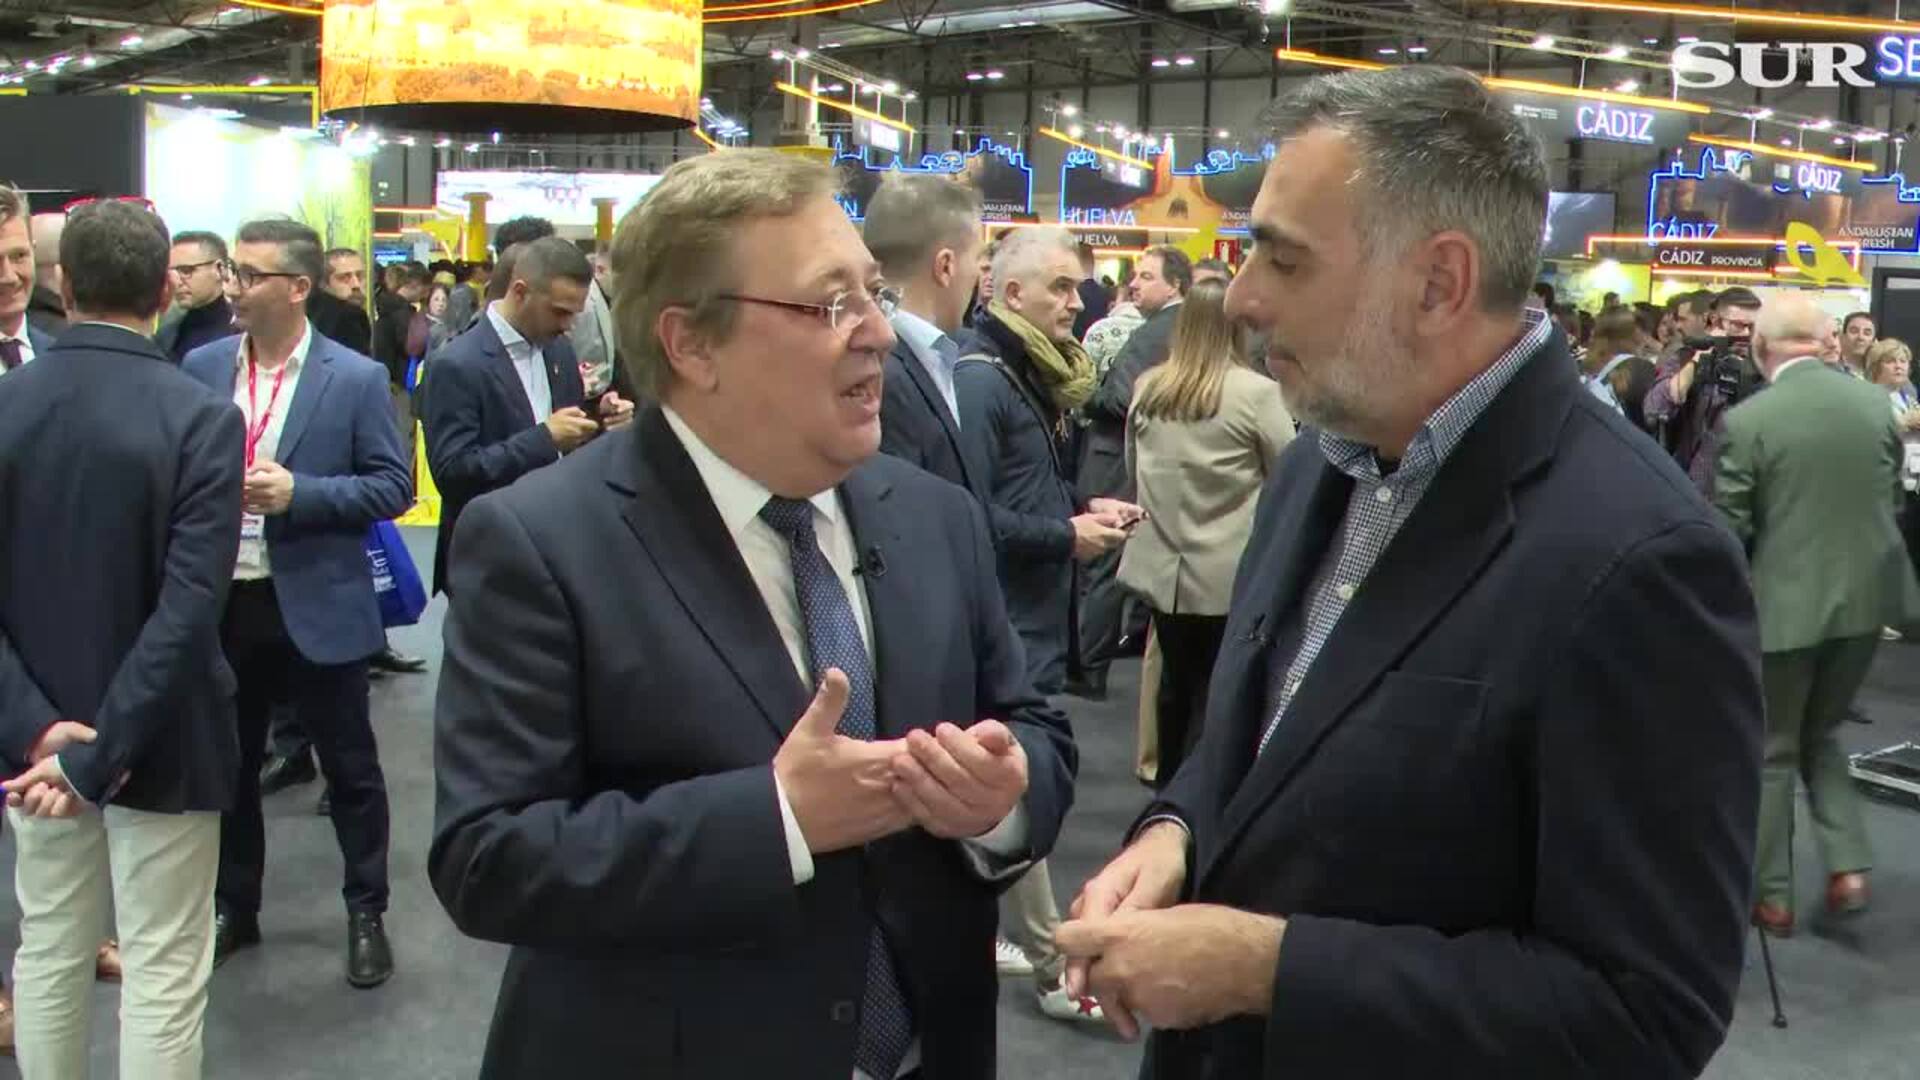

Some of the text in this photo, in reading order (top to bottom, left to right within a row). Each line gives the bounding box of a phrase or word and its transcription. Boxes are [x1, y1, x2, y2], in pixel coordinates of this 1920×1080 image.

[1577, 102, 1654, 142] CÁDIZ
[1797, 163, 1843, 193] CÁDIZ
[1650, 216, 1719, 240] CÁDIZ
[1838, 226, 1915, 238] ANDALUSIAN
[1659, 247, 1764, 267] CÁDIZ PROVINCIA
